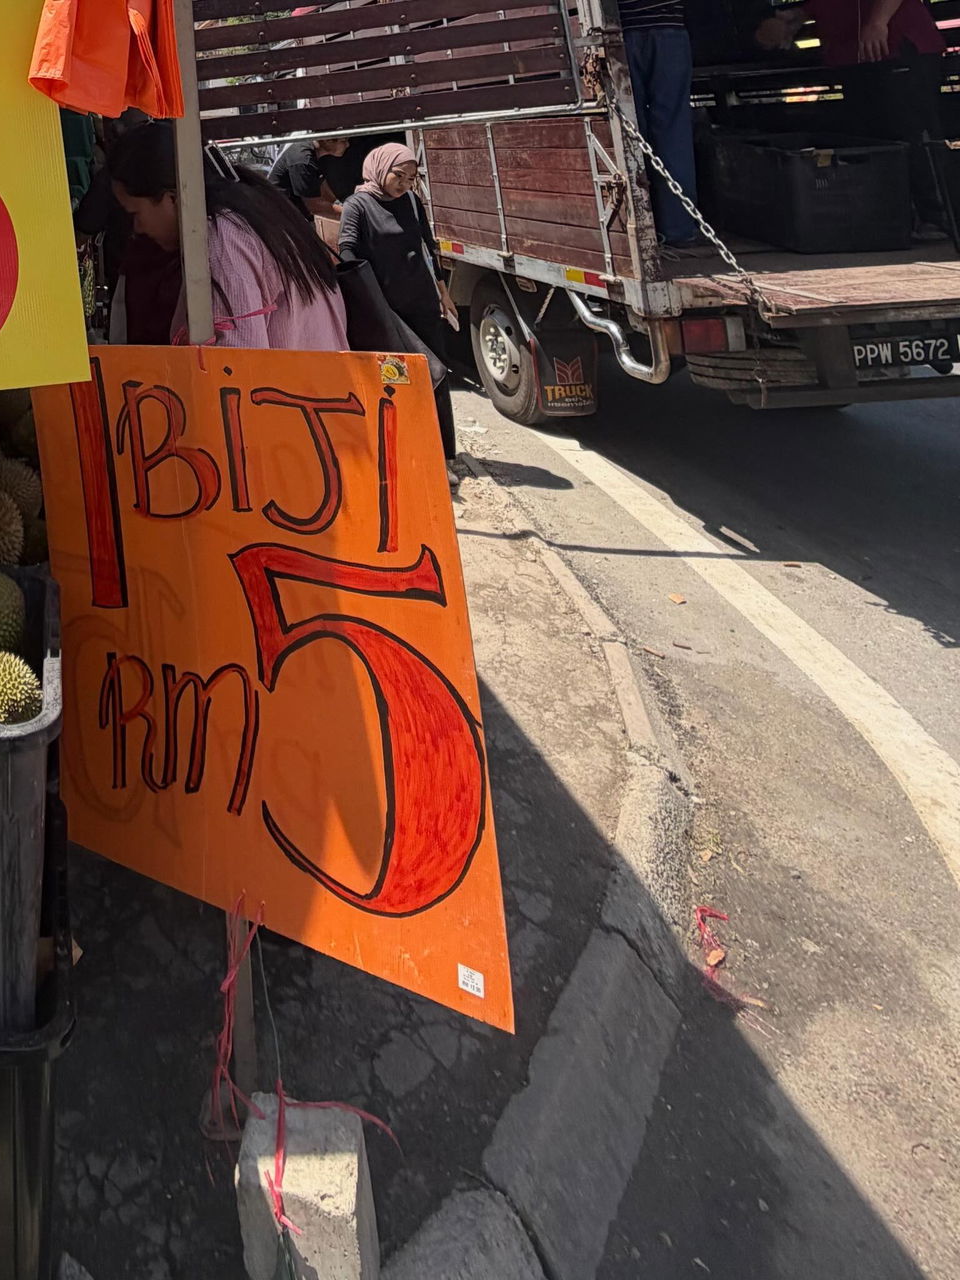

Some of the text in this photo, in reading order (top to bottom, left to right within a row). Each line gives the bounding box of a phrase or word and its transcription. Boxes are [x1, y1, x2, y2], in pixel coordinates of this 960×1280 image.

[853, 338, 950, 366] PPW 5672
[544, 384, 593, 401] TRUCK
[228, 543, 486, 918] 5
